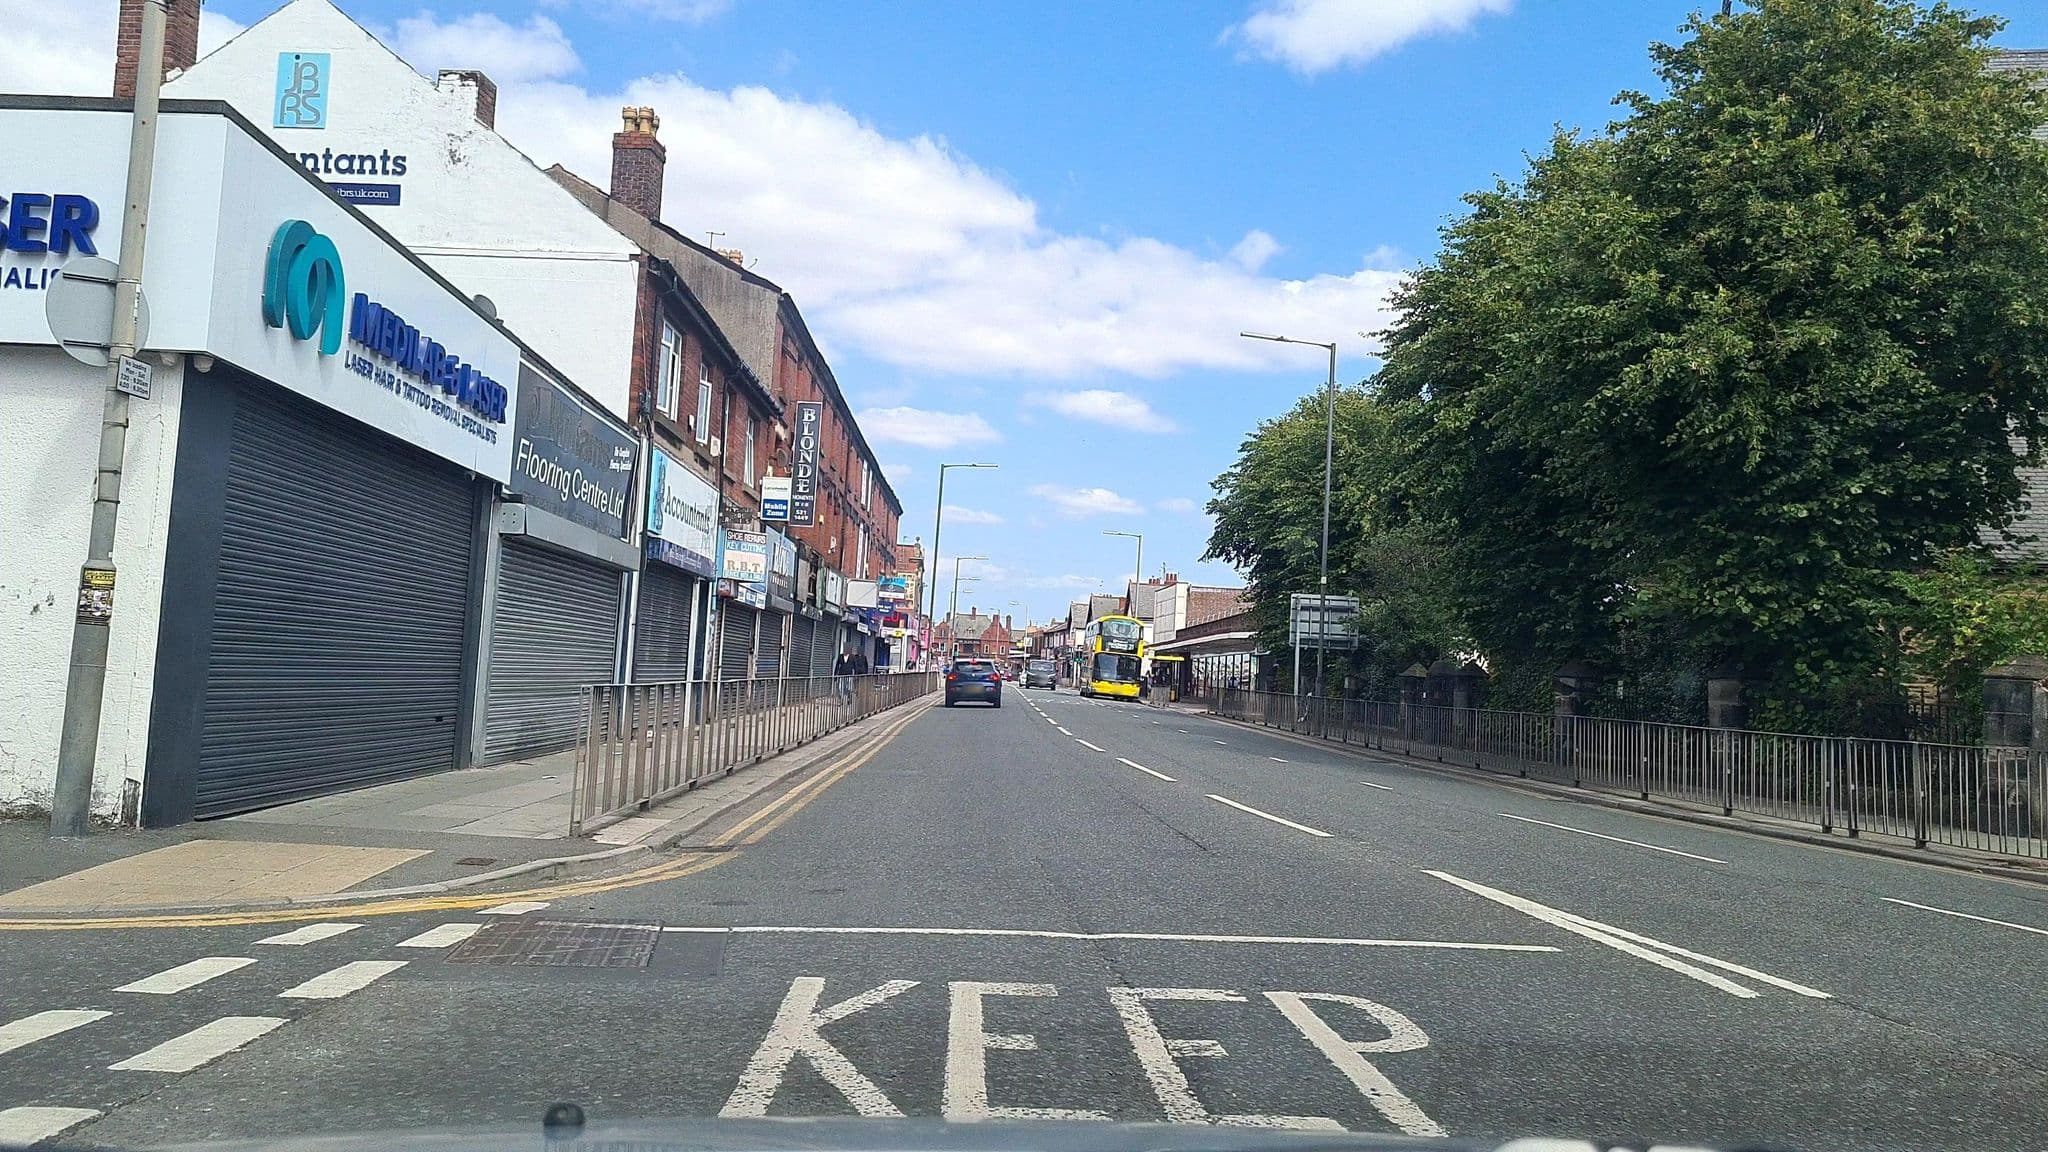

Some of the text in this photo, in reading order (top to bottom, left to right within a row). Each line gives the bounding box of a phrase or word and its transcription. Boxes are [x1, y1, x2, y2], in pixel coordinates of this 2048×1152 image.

[288, 148, 407, 176] ntants
[350, 293, 446, 387] MEDILAB
[459, 363, 508, 424] LASER
[344, 350, 374, 380] LASER
[374, 368, 395, 394] HAIR
[402, 382, 431, 410] TATTOO
[430, 397, 461, 427] REMOVAL
[461, 414, 497, 445] SPECIALISTS
[516, 438, 572, 501] Flooring
[572, 468, 608, 513] Centre
[608, 488, 626, 519] Ltd
[796, 408, 816, 493] BLONDE
[665, 485, 711, 535] Accountants
[727, 531, 766, 544] SHOE REPAIRS
[726, 560, 763, 573] R.B.T.
[727, 541, 766, 554] KEY CUTTING
[718, 977, 1449, 1137] KEEP
